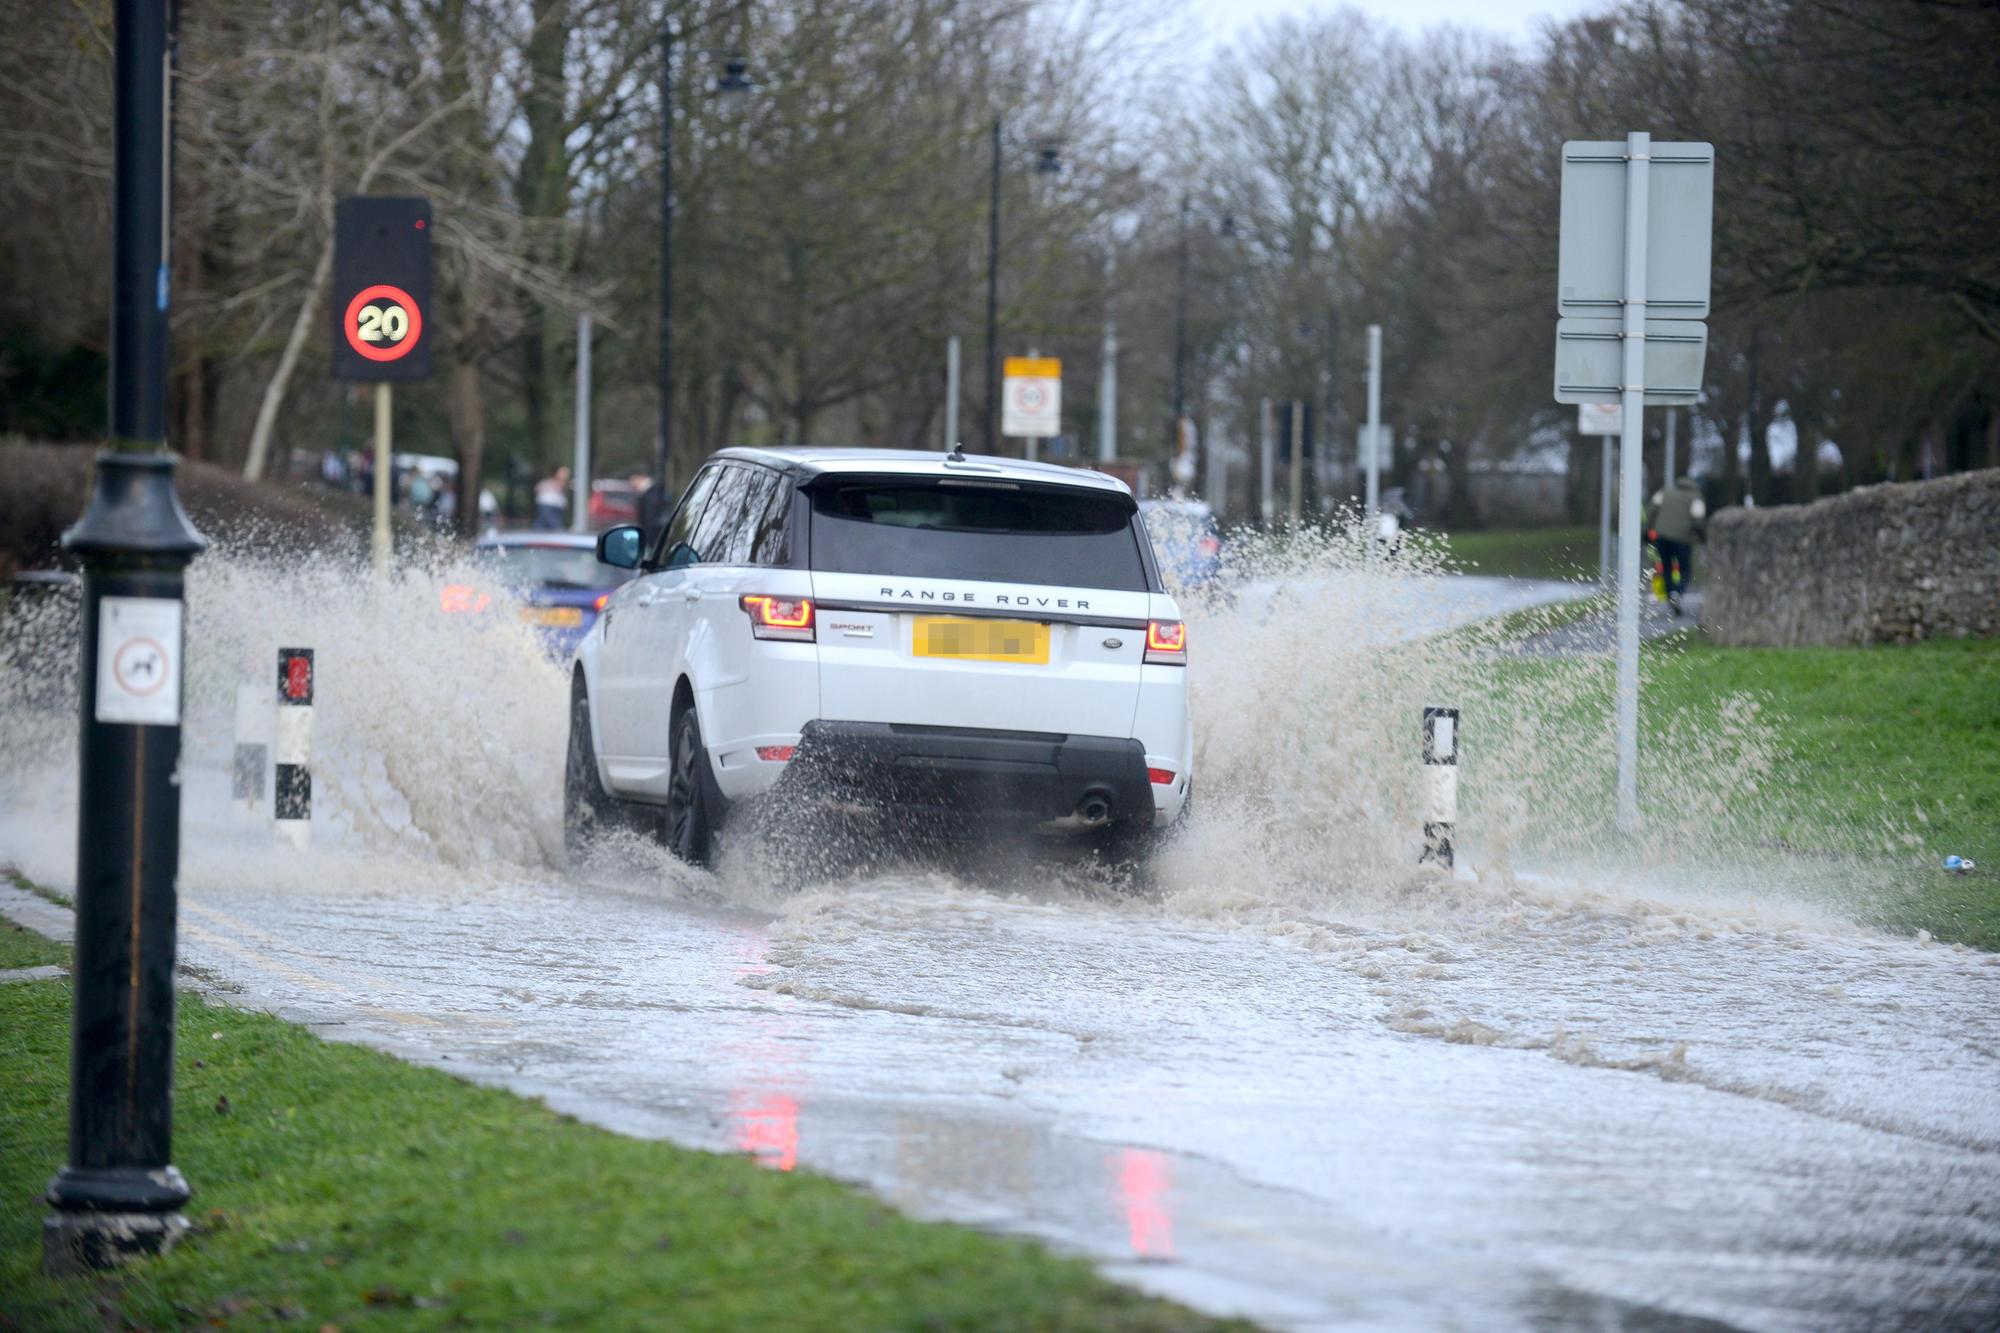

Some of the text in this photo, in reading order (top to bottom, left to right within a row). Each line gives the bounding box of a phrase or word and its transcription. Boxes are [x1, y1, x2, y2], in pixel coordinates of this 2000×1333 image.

[358, 305, 409, 341] 20
[880, 587, 1089, 609] RANGE ROVER
[830, 623, 873, 631] SPORT
